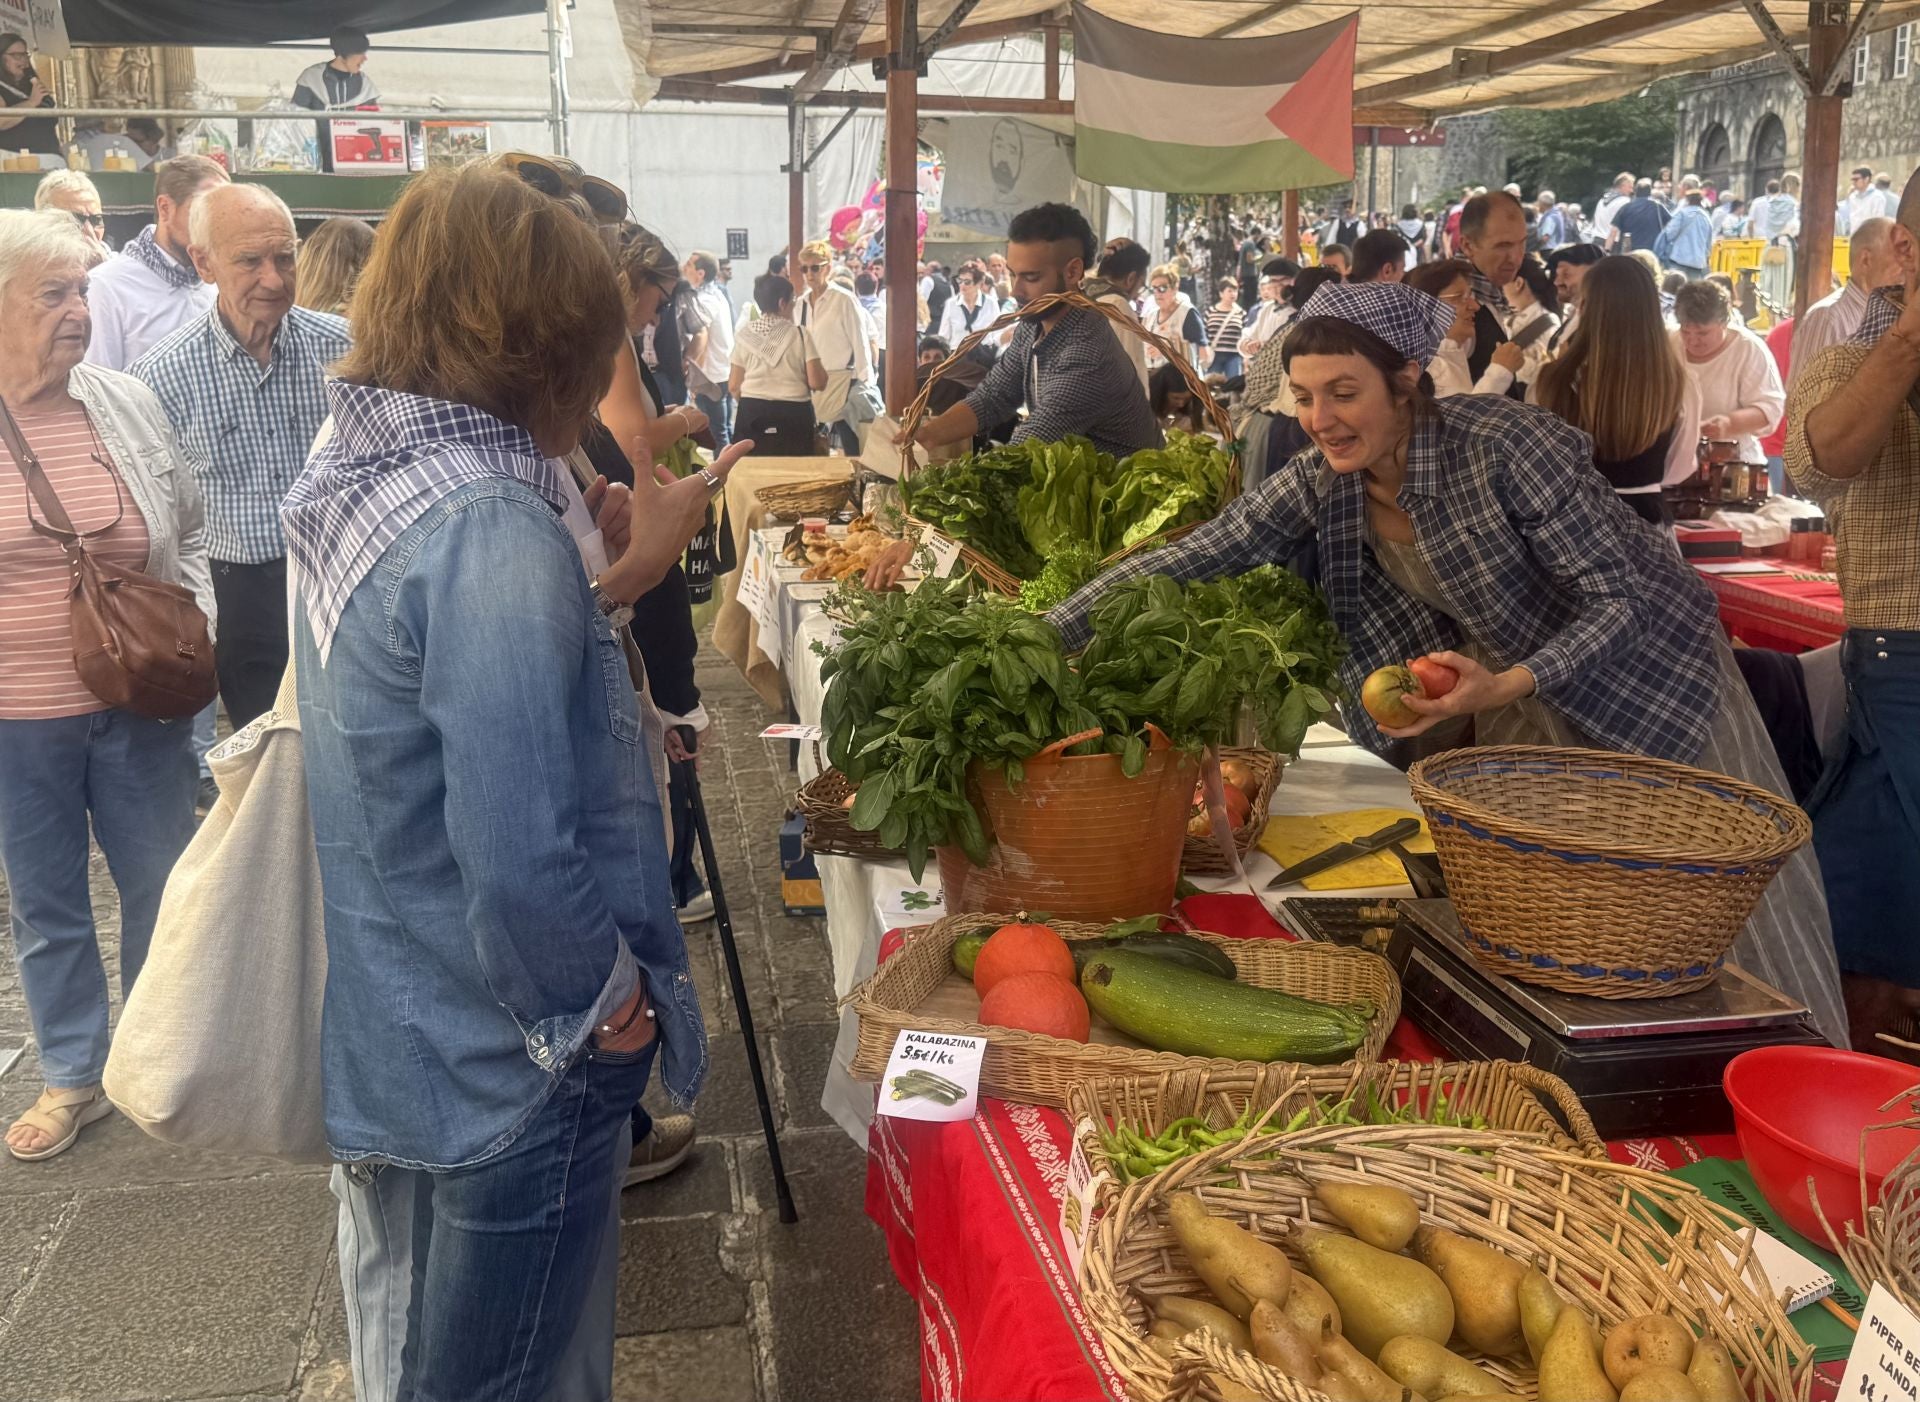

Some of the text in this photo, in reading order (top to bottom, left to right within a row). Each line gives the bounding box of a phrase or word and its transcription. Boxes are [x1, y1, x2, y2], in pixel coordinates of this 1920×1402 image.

[906, 1033, 977, 1049] KALABAZINA
[1870, 1315, 1920, 1377] PIPER BE
[1879, 1354, 1917, 1402] LANDA
